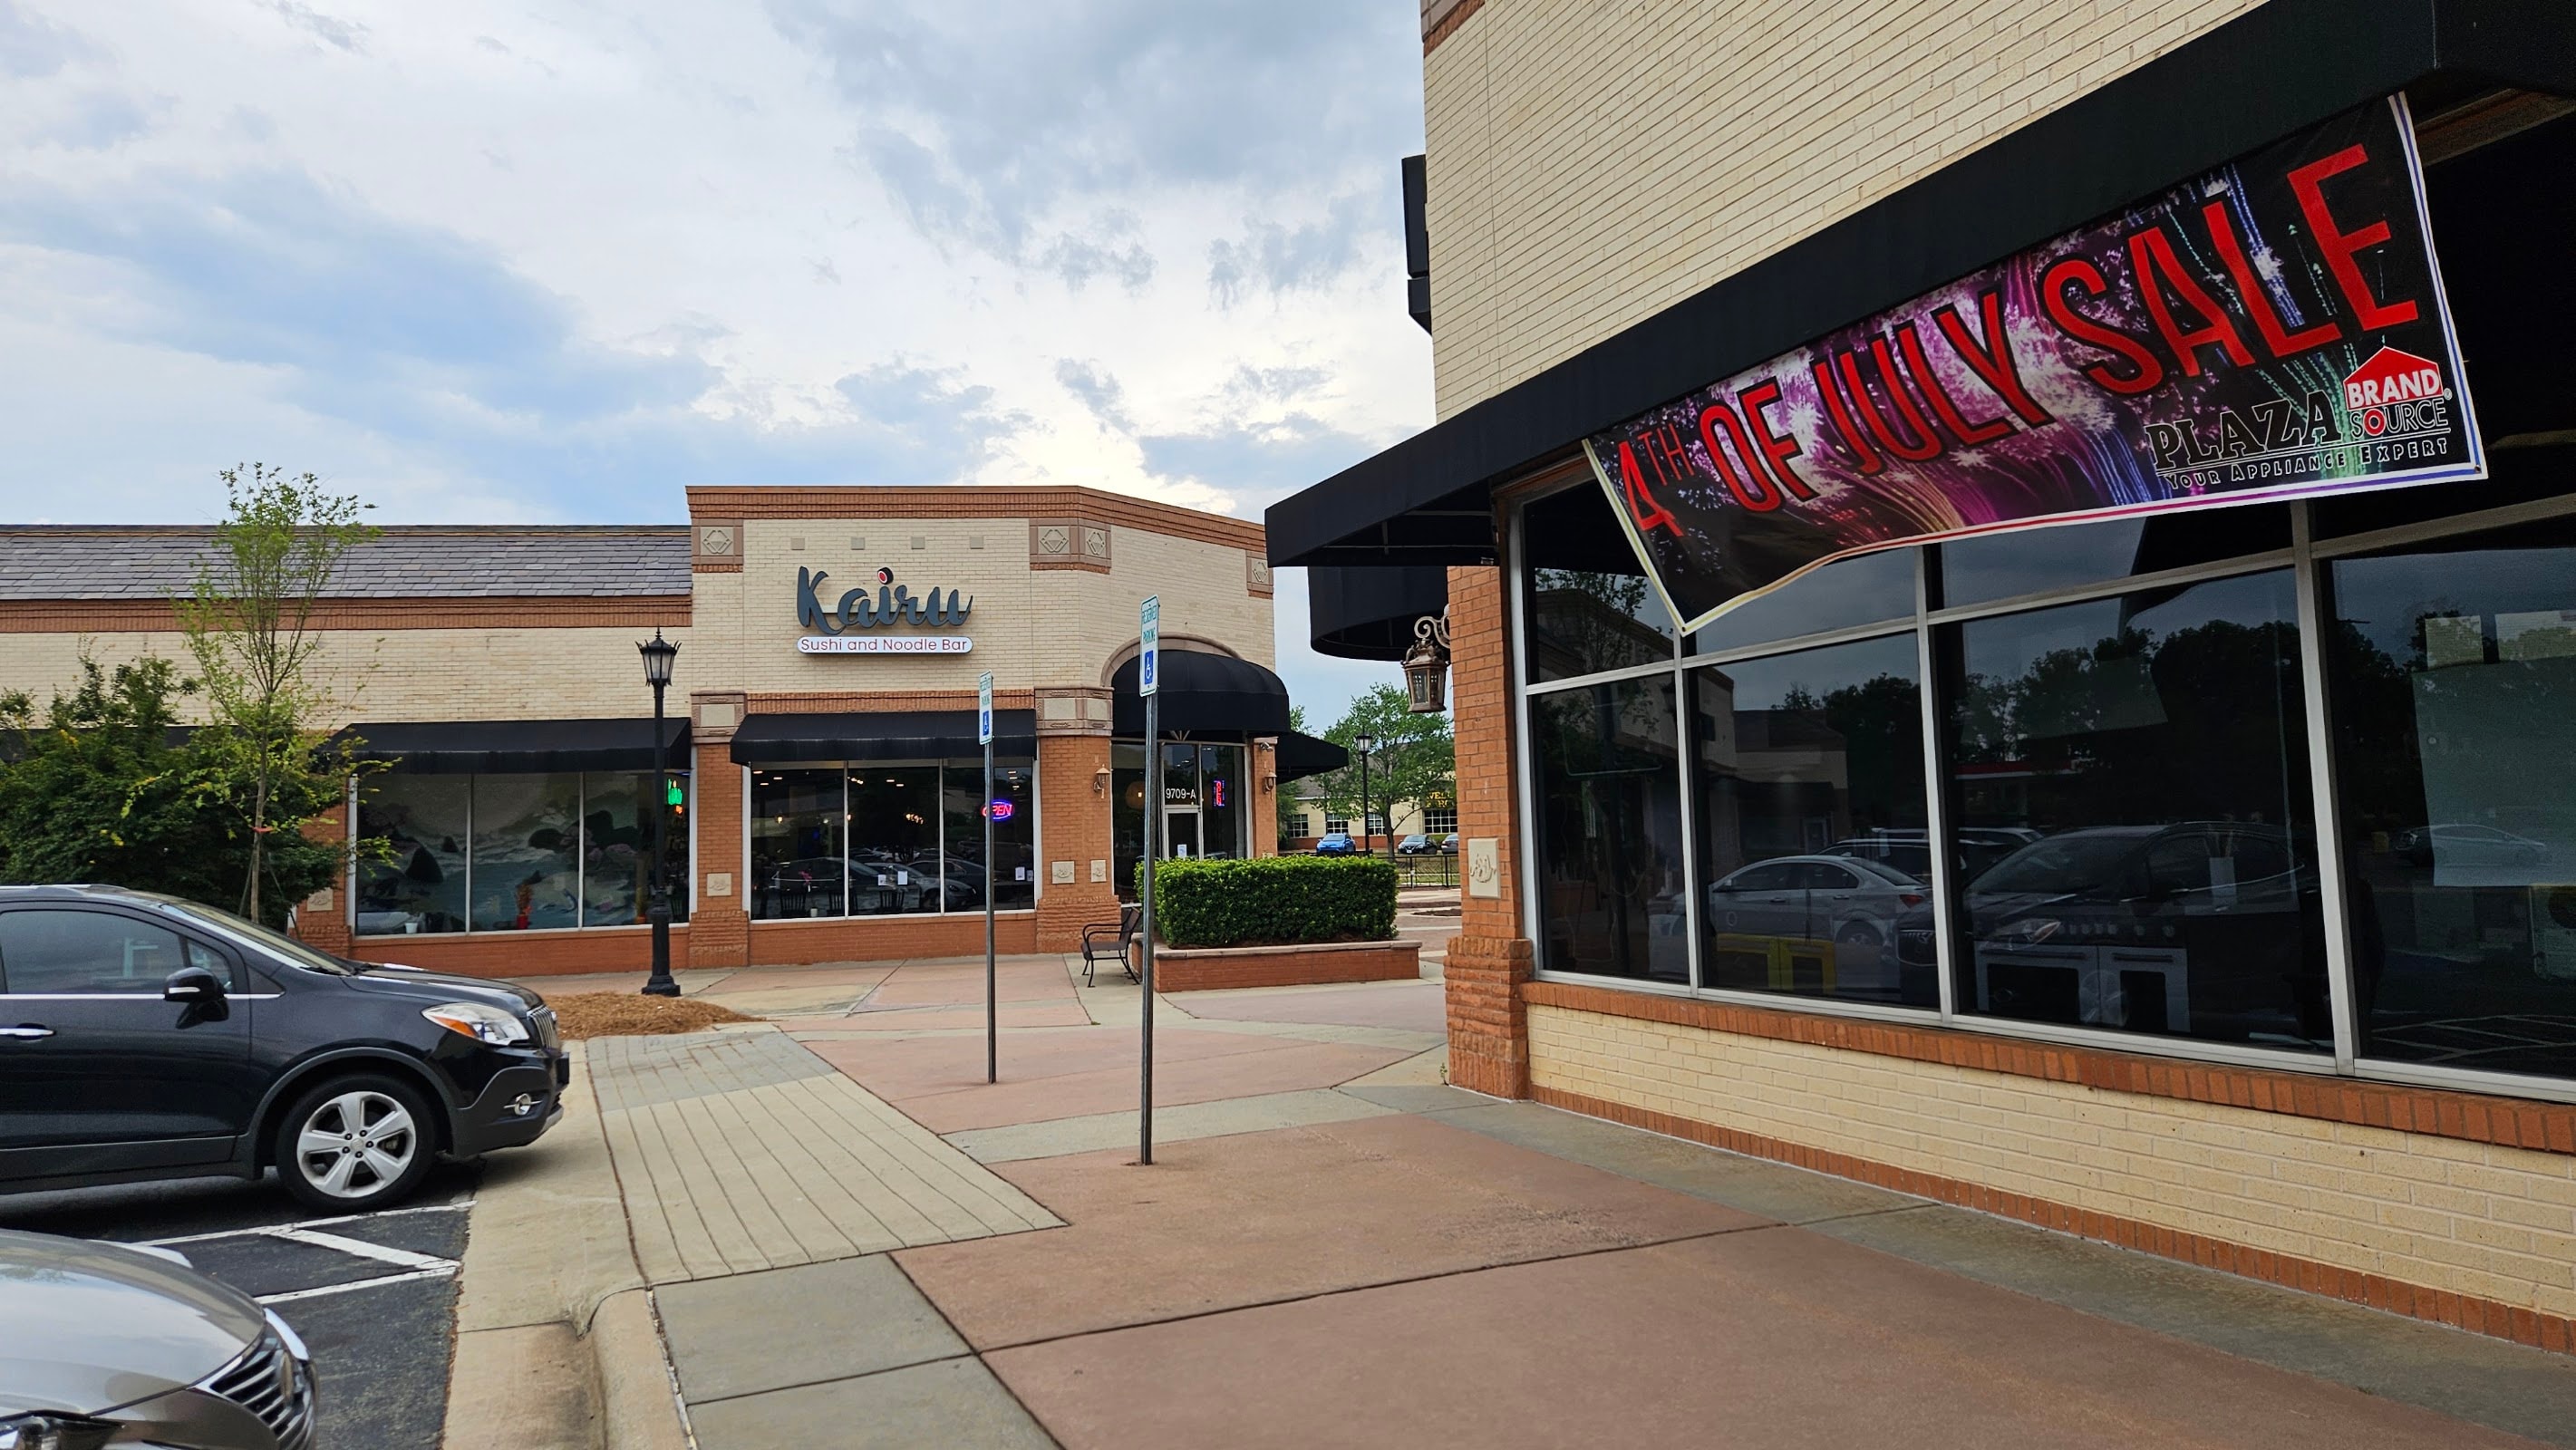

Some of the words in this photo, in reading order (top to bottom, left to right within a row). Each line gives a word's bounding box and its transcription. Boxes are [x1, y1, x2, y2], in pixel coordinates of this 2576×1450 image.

[1618, 424, 1693, 538] 4TH
[1699, 383, 1818, 514] OF
[1813, 292, 2055, 478] JULY
[2041, 143, 2419, 396] SALE
[2347, 368, 2443, 408] BRAND
[2145, 390, 2343, 469] PLAZA
[2349, 398, 2449, 440] SOURCE
[2164, 471, 2221, 489] YOUR
[2231, 452, 2347, 481] APPLIANCE
[2360, 438, 2448, 464] EXPERT
[797, 566, 973, 635] Kairu
[801, 639, 842, 651] Sushi
[847, 639, 877, 651] and
[883, 639, 937, 651] Noodle
[942, 639, 967, 651] Bar
[1166, 788, 1196, 799] 9709-A
